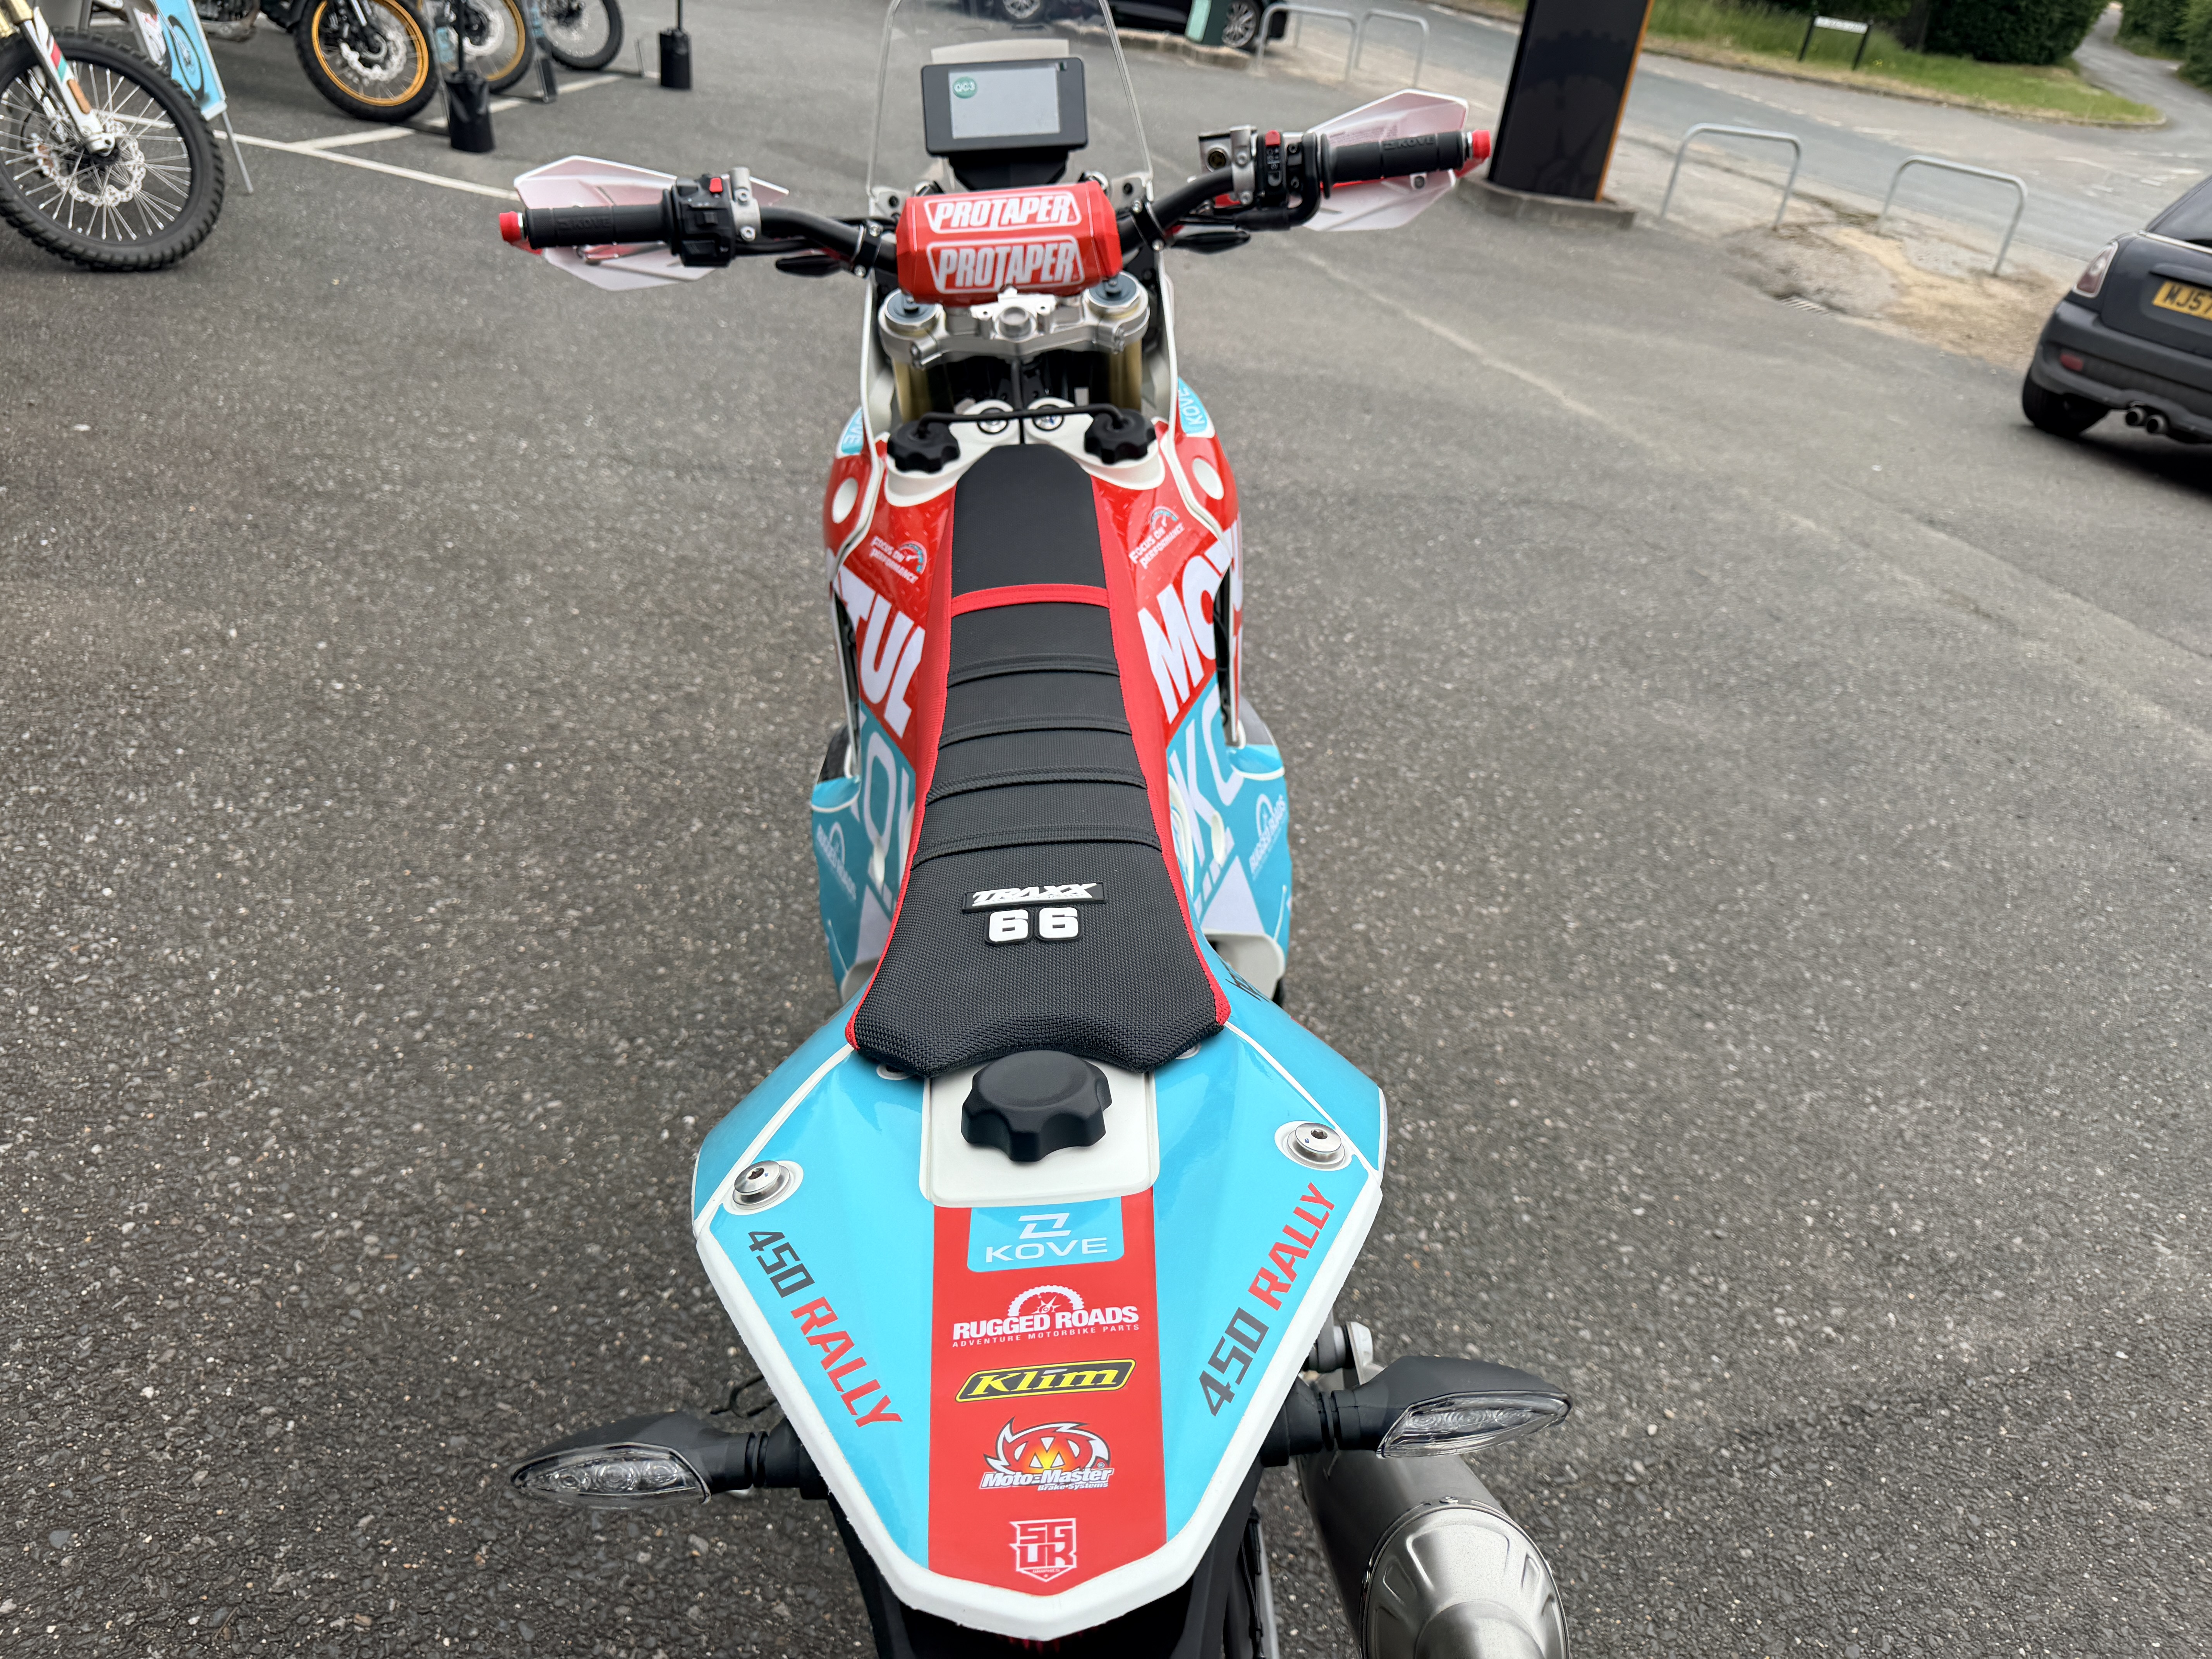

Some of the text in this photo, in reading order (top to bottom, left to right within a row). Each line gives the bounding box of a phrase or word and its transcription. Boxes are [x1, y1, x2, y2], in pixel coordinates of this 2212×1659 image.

[936, 193, 1072, 230] PROTAPER
[938, 241, 1077, 289] PROTAPER
[1129, 526, 1166, 564] FOCUS ON
[972, 883, 1097, 907] TRAXX
[989, 907, 1079, 942] 66
[985, 1237, 1108, 1263] KOVE
[1199, 1182, 1335, 1417] 450 RALLY
[748, 1231, 903, 1428] 450 RALLY
[952, 1305, 1139, 1340] RUGGED ROADS
[952, 1324, 1140, 1348] ADVENTURE MOTORBIKE PARTS
